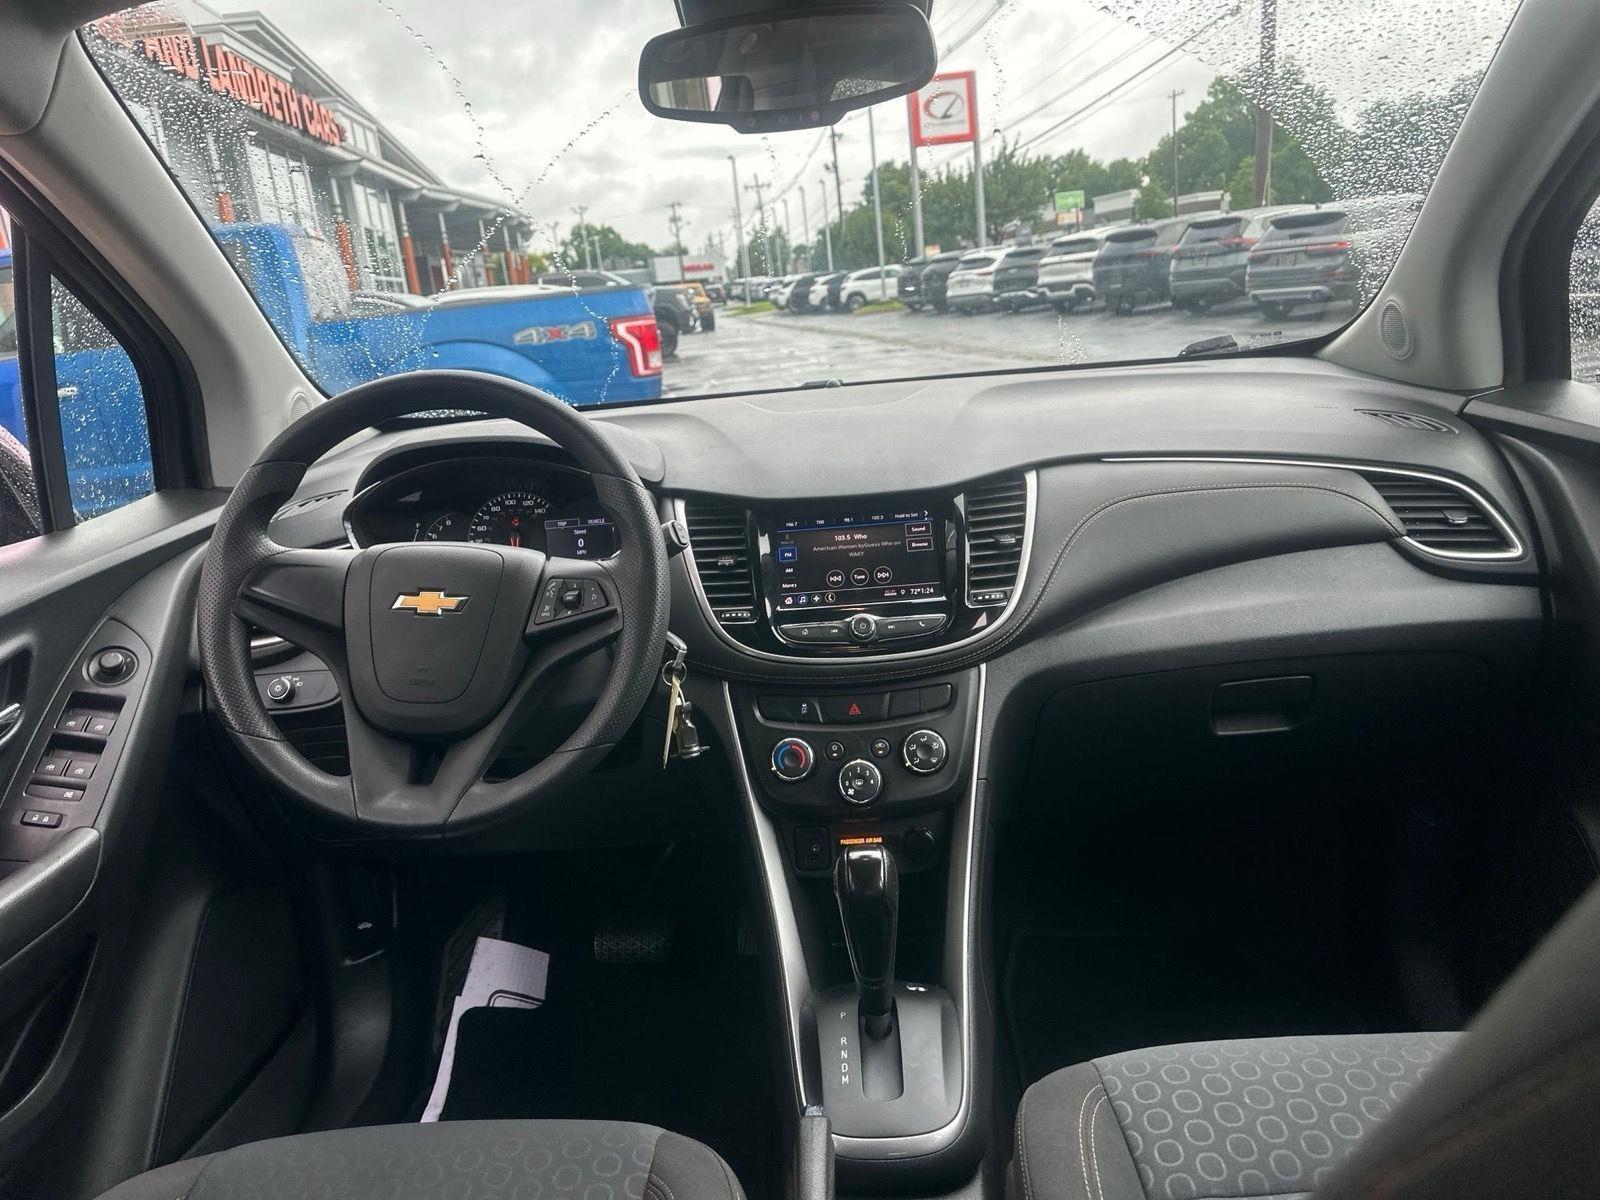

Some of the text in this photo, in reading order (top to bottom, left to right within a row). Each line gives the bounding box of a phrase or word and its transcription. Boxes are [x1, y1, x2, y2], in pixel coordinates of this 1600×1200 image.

[200, 36, 302, 129] LANDRETH
[300, 94, 342, 146] CARS
[577, 538, 584, 547] 0
[840, 1036, 847, 1045] R
[841, 1050, 848, 1059] N
[841, 1063, 849, 1072] D
[842, 1075, 849, 1084] M
